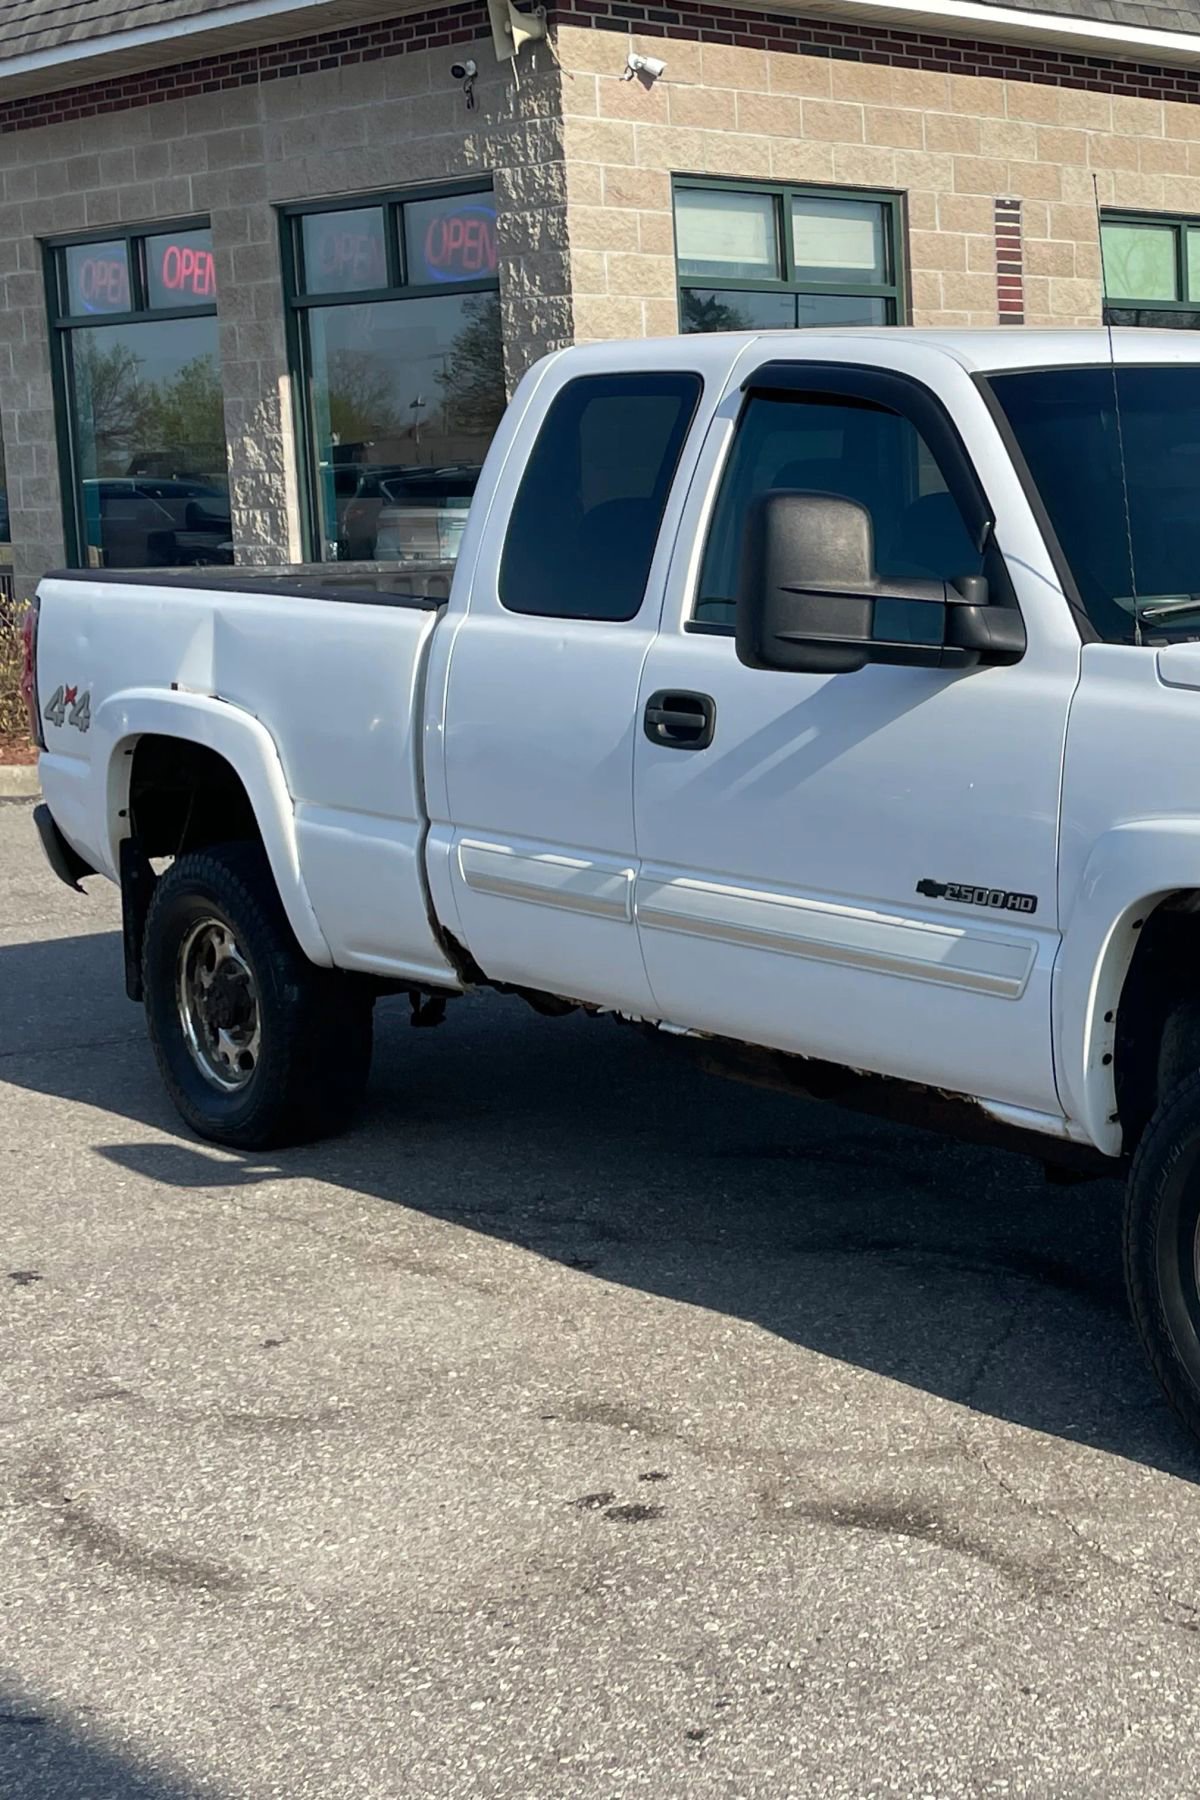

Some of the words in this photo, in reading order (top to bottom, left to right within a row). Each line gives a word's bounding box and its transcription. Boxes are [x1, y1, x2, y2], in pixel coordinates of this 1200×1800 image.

[425, 217, 497, 272] OPEN
[944, 884, 1004, 908] 2500
[1007, 896, 1033, 912] HD
